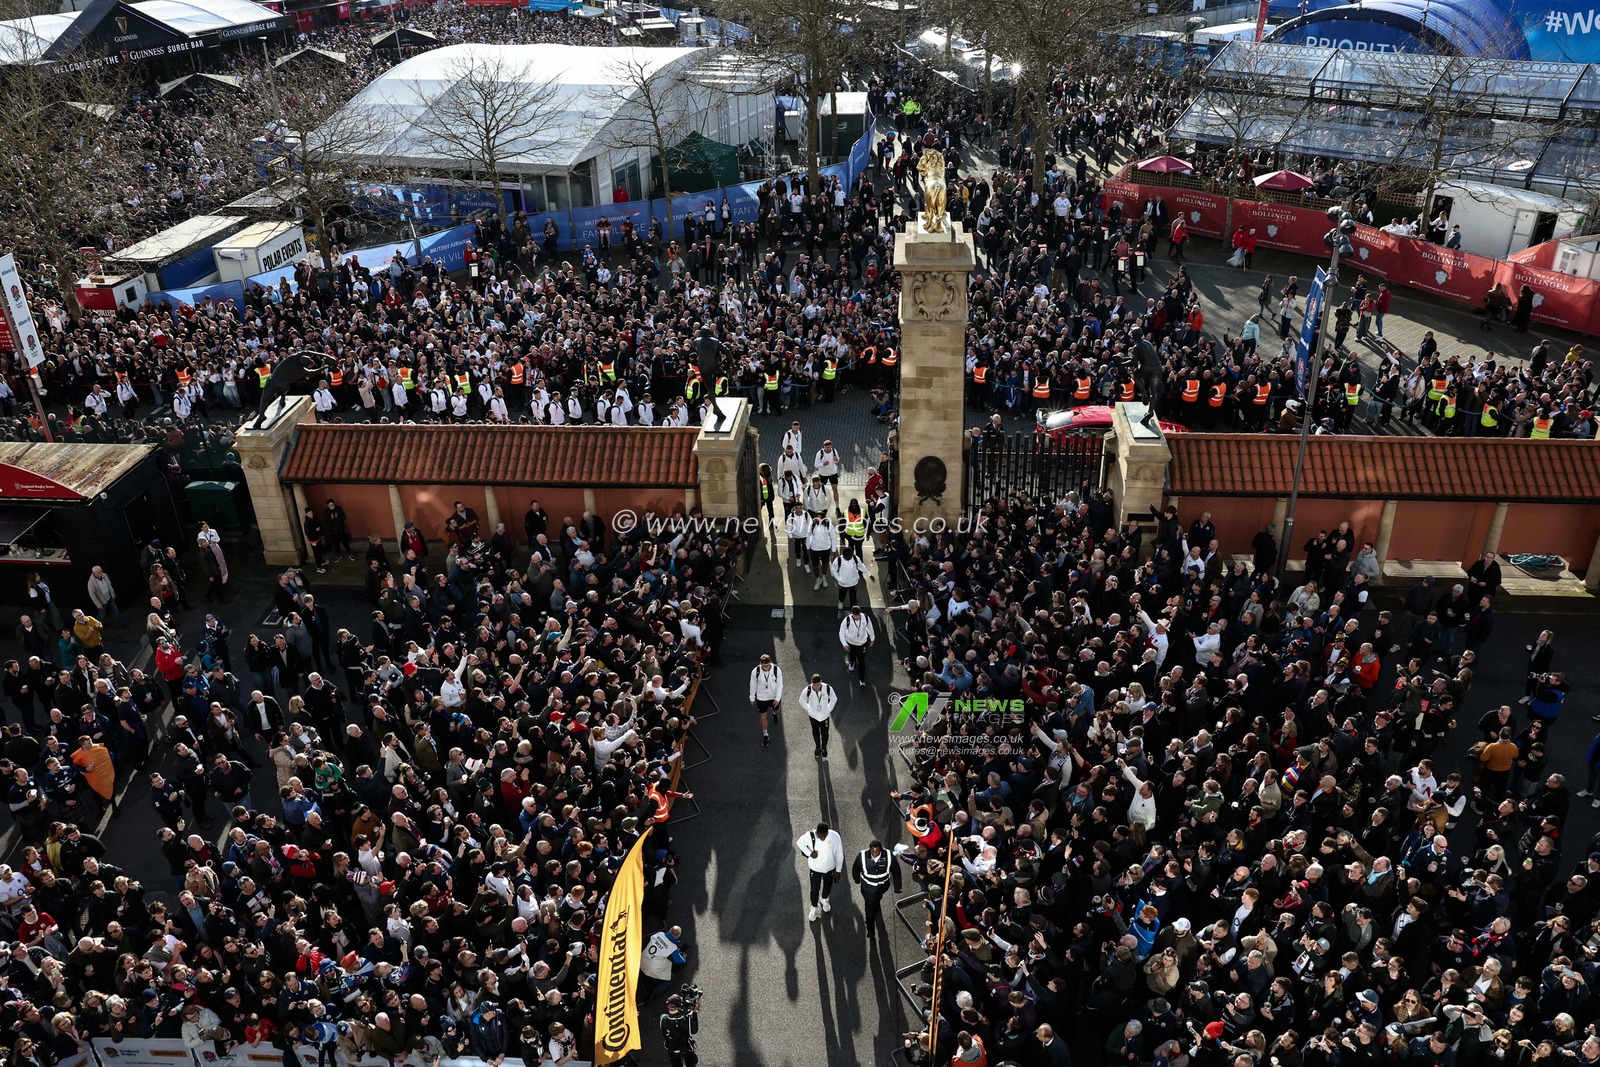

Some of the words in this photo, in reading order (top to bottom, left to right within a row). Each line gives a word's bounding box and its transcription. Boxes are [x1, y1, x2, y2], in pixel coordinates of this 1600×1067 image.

[248, 23, 266, 33] SURGE
[266, 21, 277, 29] BAR
[113, 33, 138, 42] GUINNESS
[104, 55, 120, 65] THE
[130, 46, 165, 60] GUINNESS
[167, 42, 189, 54] SURGE
[191, 39, 204, 49] BAR
[1104, 187, 1140, 198] OLLINGER
[1176, 197, 1217, 208] BOLLINGER
[733, 207, 751, 216] FAN
[1252, 210, 1297, 222] BOLLINGER
[1350, 232, 1386, 246] OLLINGER
[430, 243, 450, 254] BRITISH
[262, 251, 282, 272] POLAR
[282, 238, 303, 264] EVENTS
[1422, 252, 1469, 270] BOLLINGER
[1514, 274, 1570, 292] BOLLINGER
[602, 926, 631, 1052] Continental
